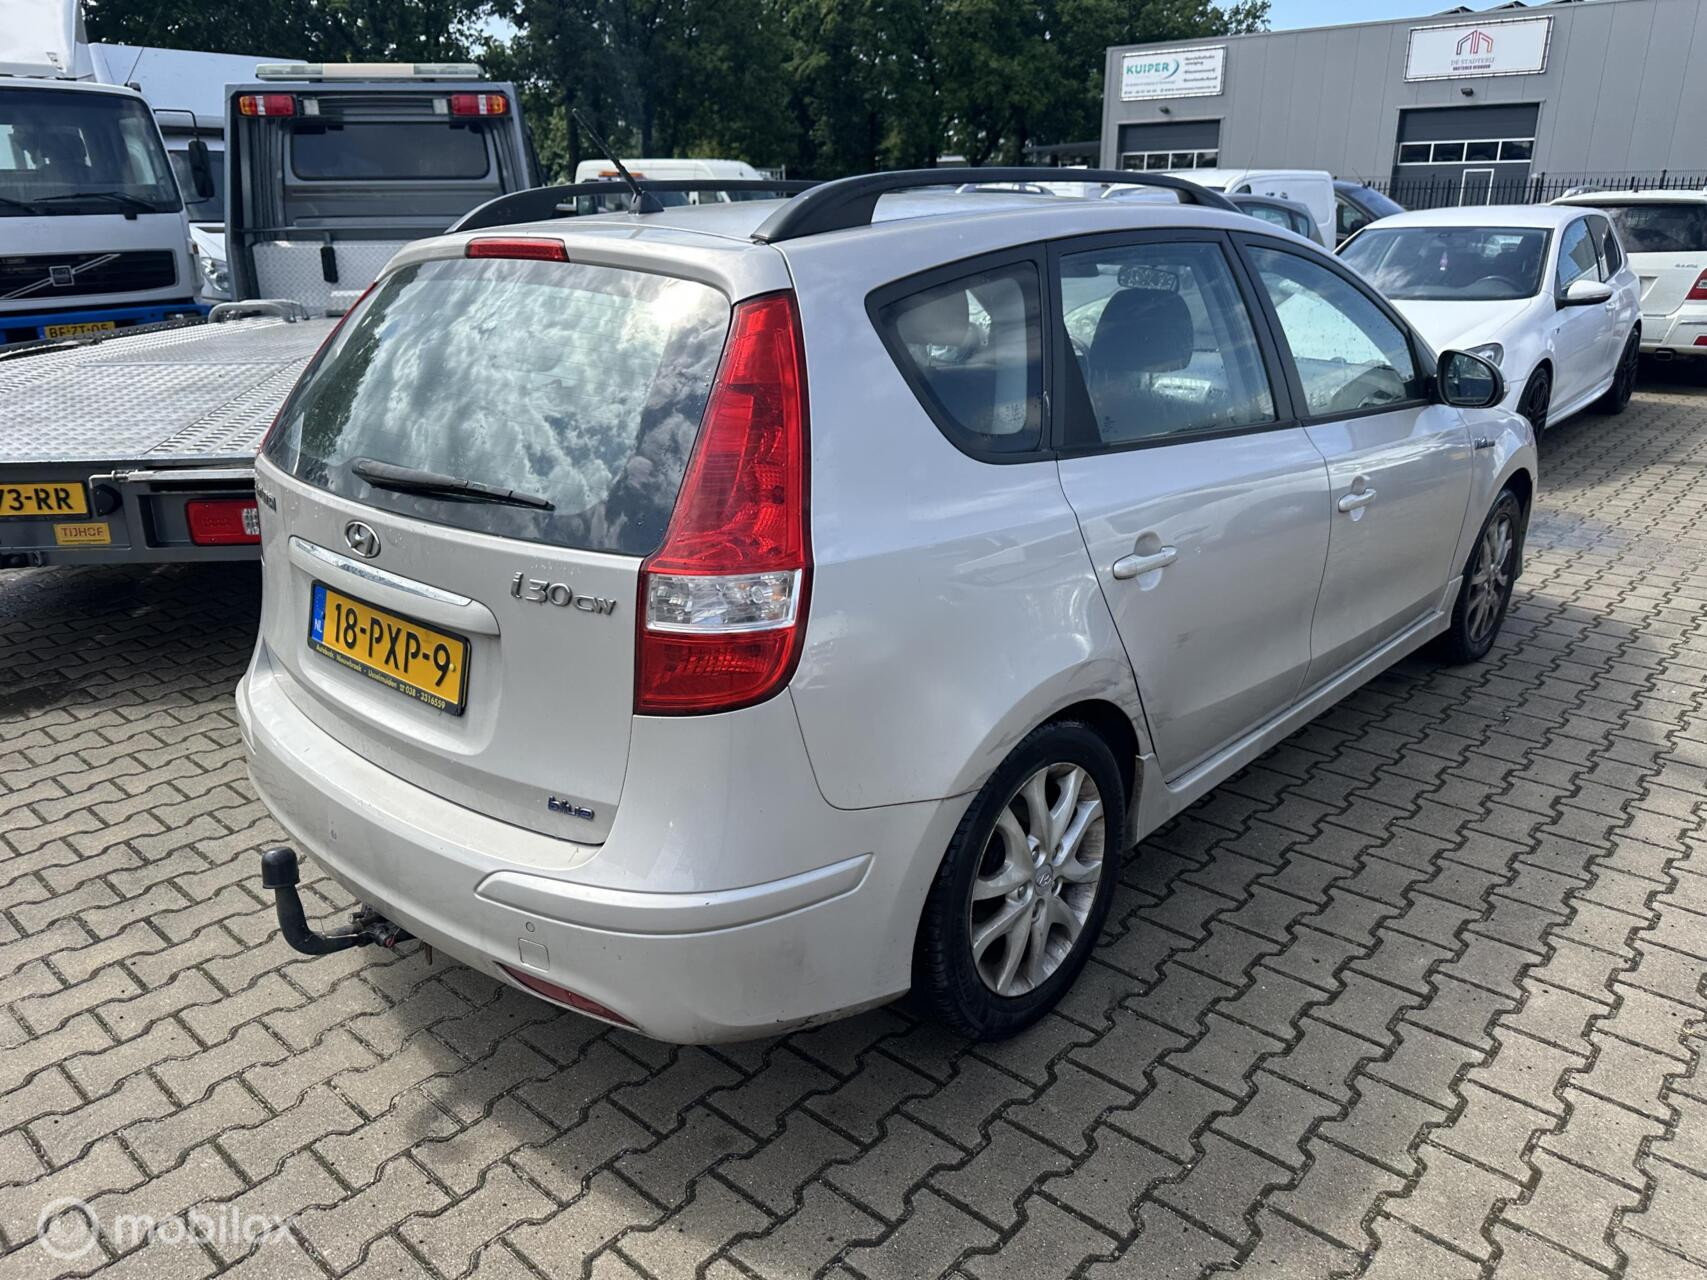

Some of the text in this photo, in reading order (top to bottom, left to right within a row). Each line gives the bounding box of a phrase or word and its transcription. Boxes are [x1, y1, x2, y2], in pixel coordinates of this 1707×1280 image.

[1126, 62, 1170, 74] KUIPER
[314, 617, 323, 633] NL
[335, 603, 450, 687] 18-PXP-9
[405, 686, 416, 697] 038
